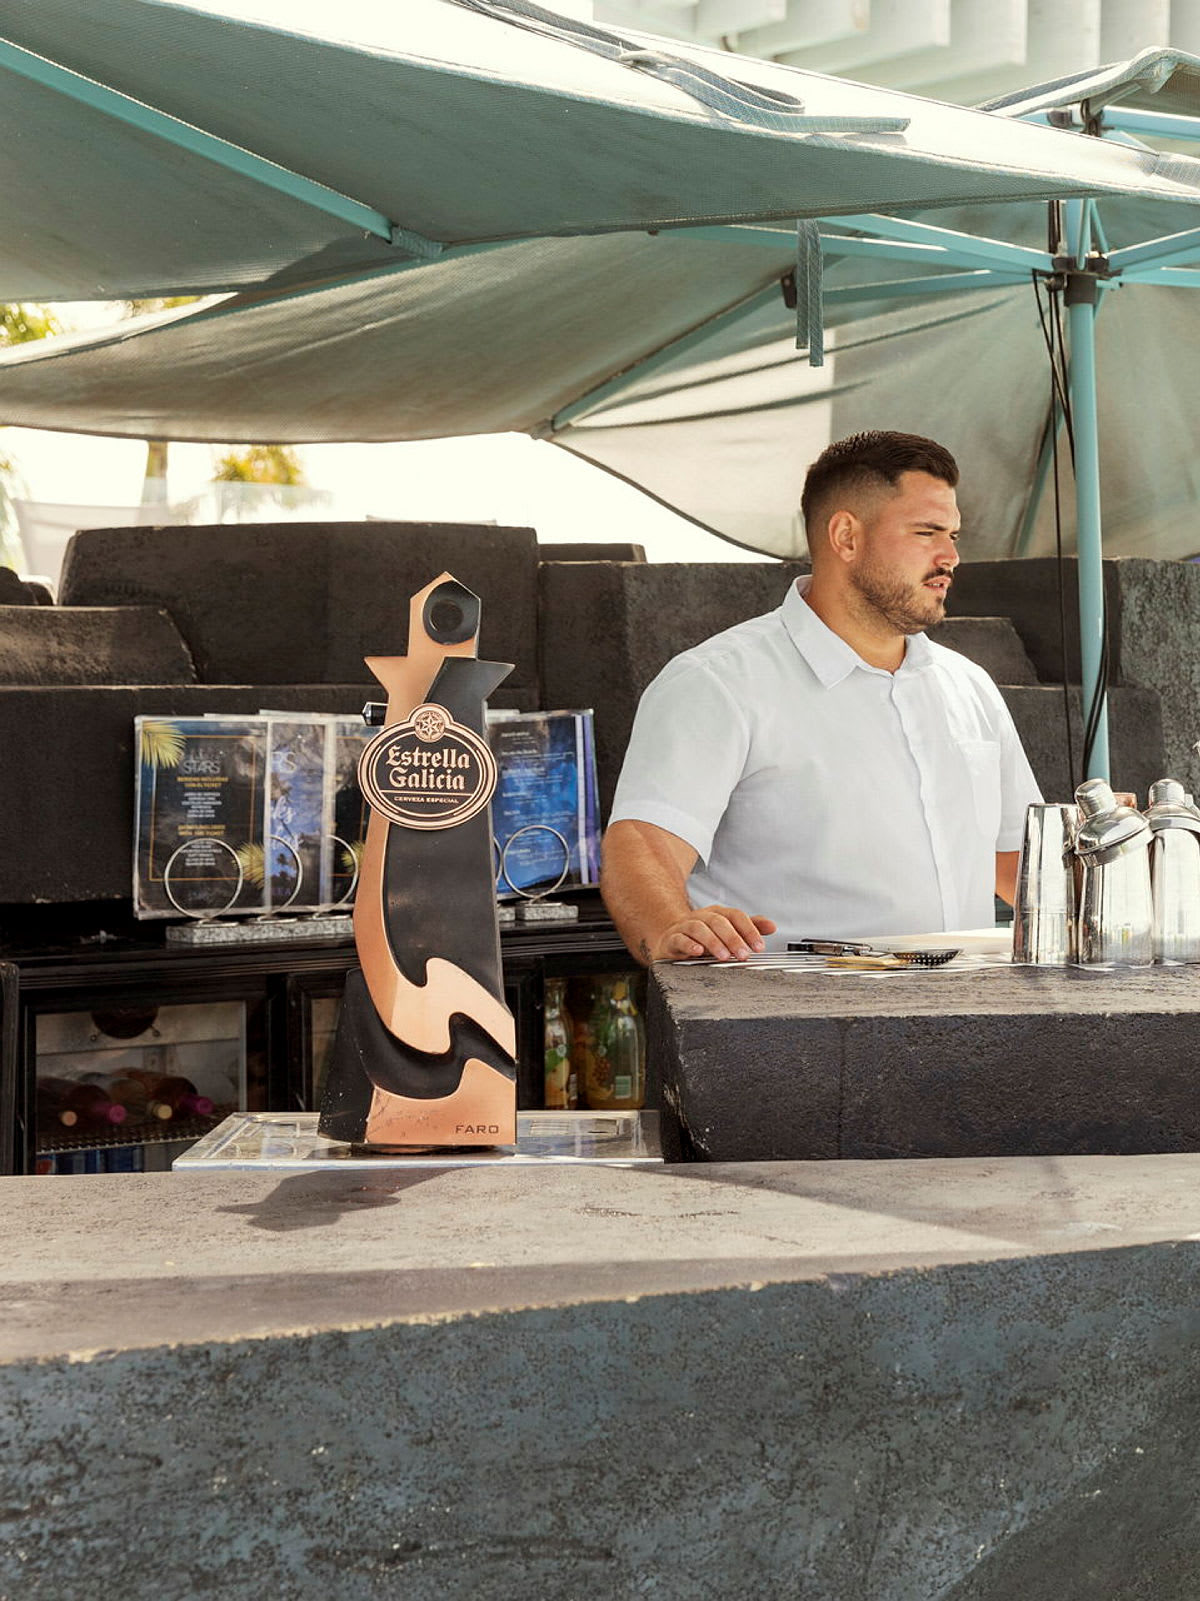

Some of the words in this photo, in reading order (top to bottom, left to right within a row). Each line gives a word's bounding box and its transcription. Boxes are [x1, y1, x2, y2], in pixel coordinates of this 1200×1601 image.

[386, 745, 470, 769] Estrella
[389, 767, 465, 790] Galicia
[455, 1124, 499, 1134] FARO
